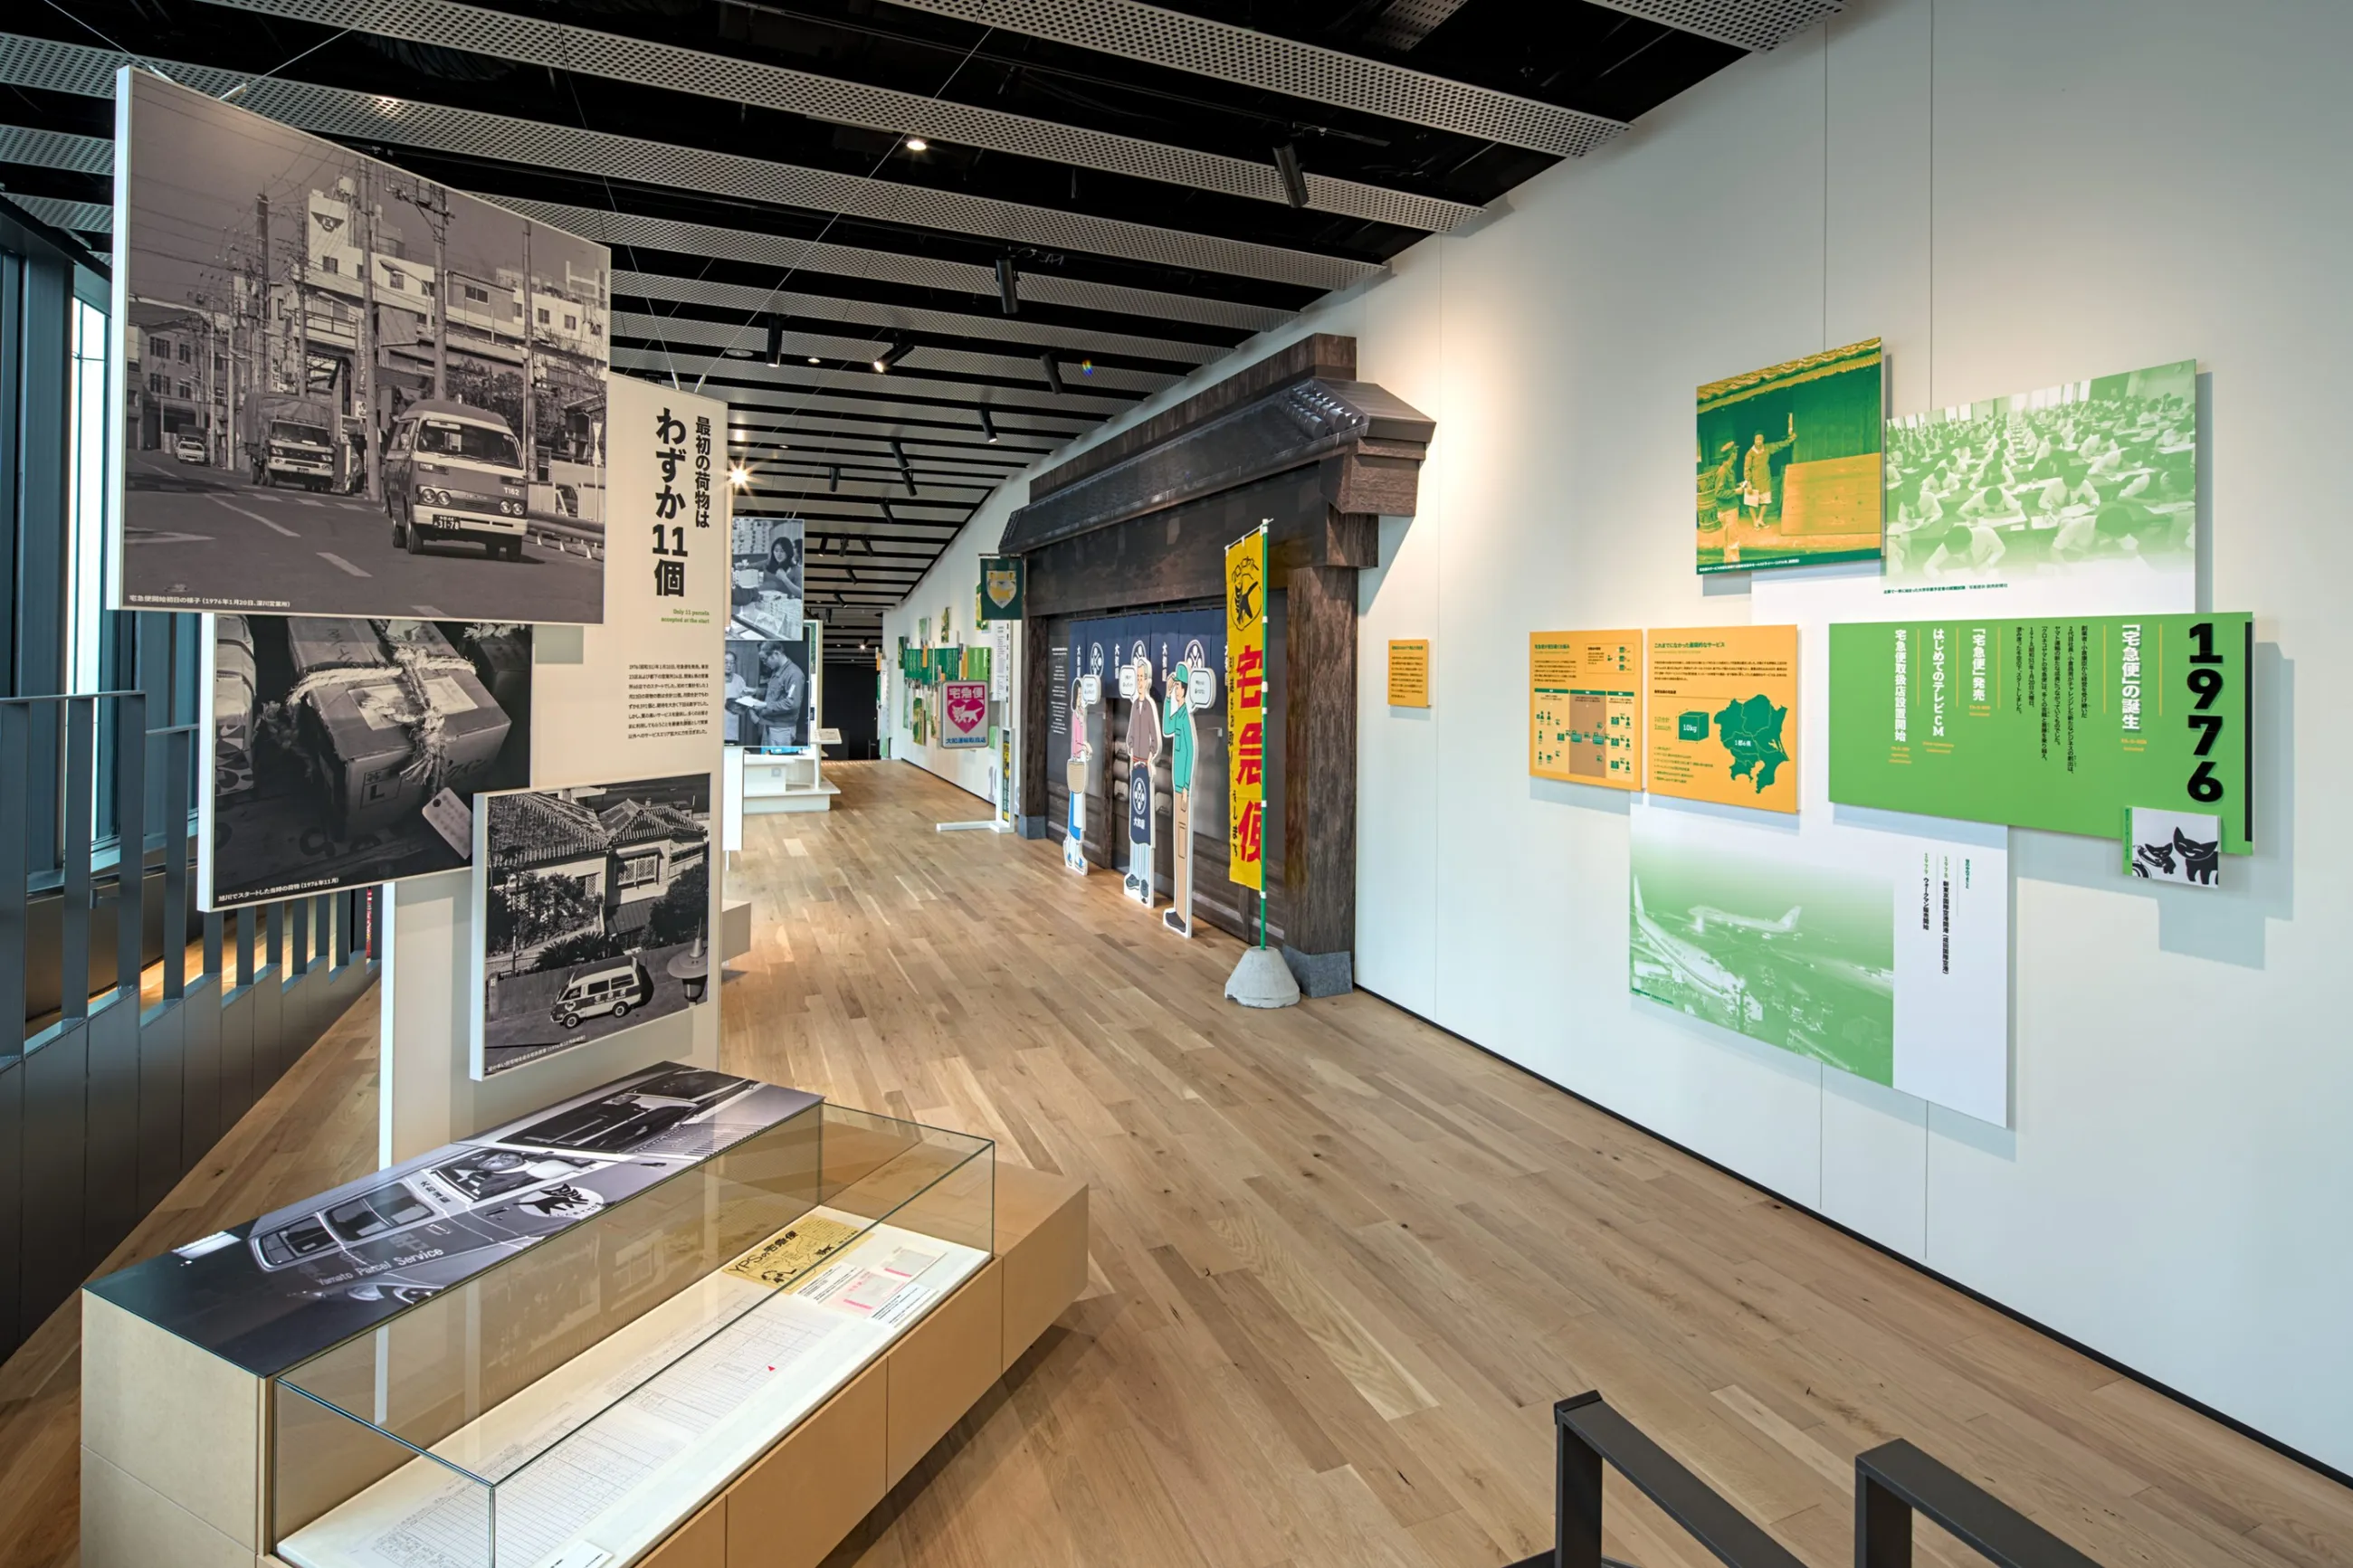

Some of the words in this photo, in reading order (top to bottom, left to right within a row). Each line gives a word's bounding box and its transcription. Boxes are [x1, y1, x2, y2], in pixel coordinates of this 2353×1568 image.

[653, 407, 688, 597] わずか11個
[695, 415, 710, 528] 最初の荷物は
[949, 687, 984, 698] 宅急便
[1895, 630, 1907, 742] 宅急便取扱店設置開始
[1932, 628, 1944, 736] はじめてのテレビCM
[1972, 628, 1986, 701] 「宅急便」発売
[2121, 624, 2140, 730] 「宅急便」の誕生
[2186, 622, 2224, 803] 1976
[1683, 724, 1697, 733] 10kg
[317, 1272, 354, 1286] Yamato
[355, 1260, 392, 1277] Parcel
[393, 1247, 444, 1267] Service
